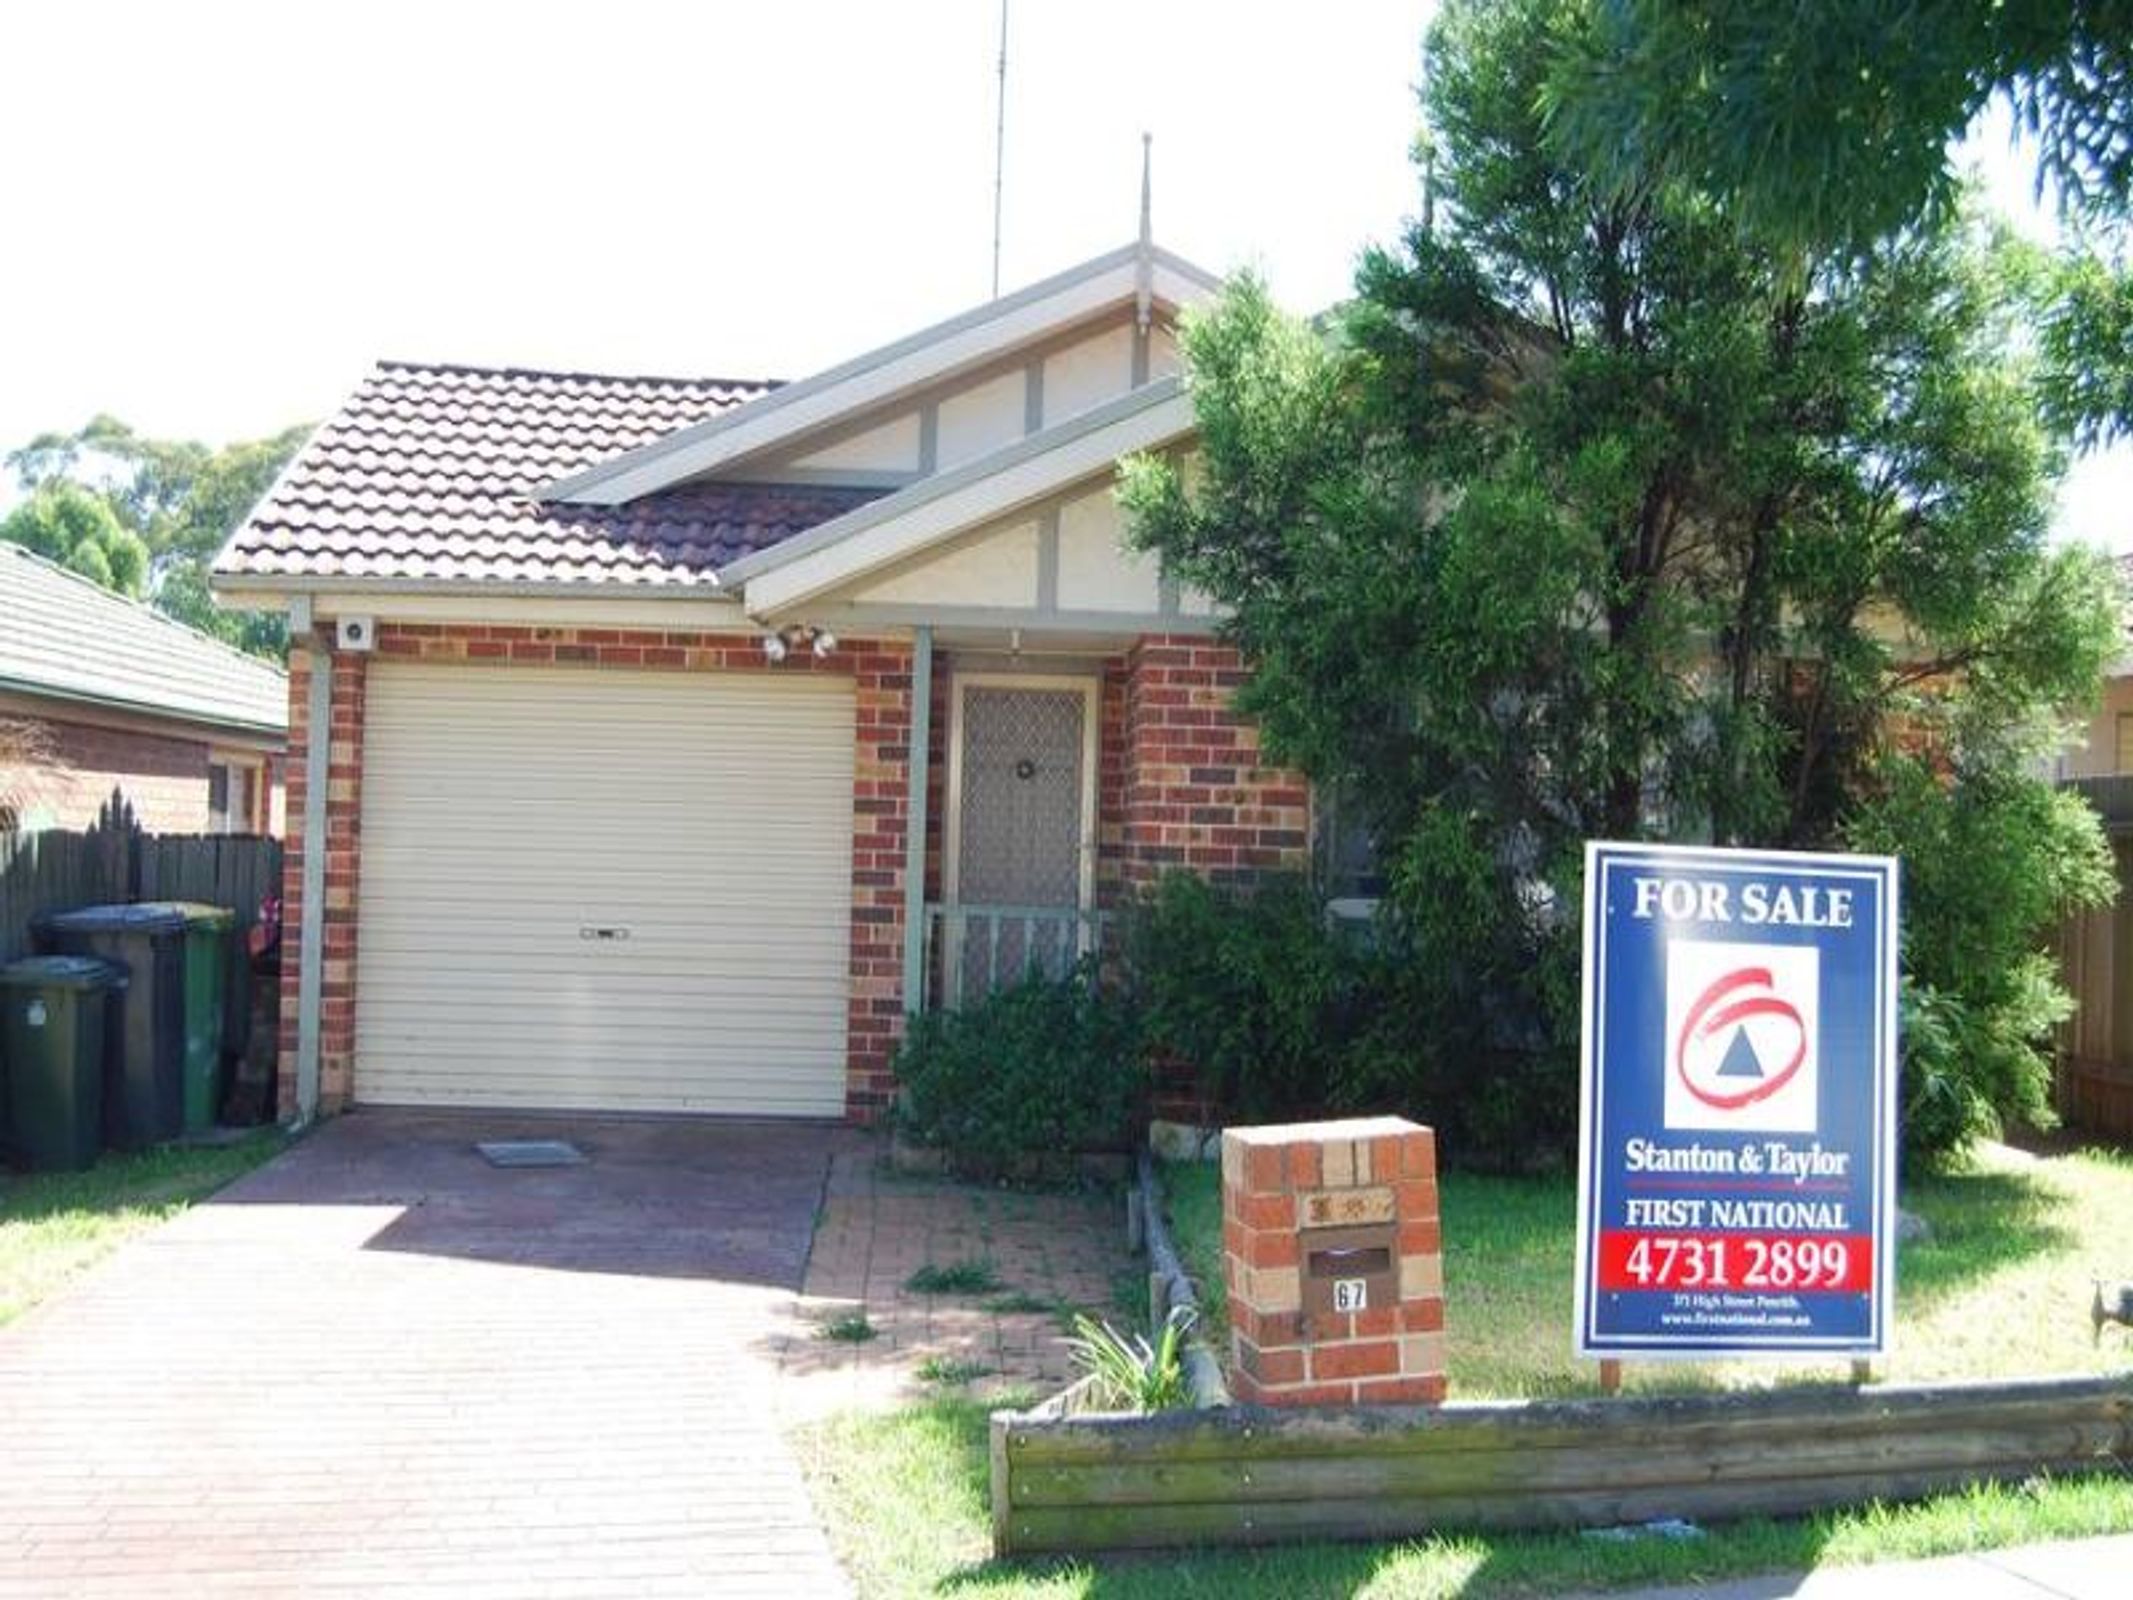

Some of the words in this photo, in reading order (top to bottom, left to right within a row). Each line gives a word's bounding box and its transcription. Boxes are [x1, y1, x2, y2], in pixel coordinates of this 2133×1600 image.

[1633, 878, 1730, 922] FOR
[1741, 885, 1853, 927] SALE
[1625, 1138, 1733, 1172] Stanton
[1738, 1147, 1763, 1173] &
[1764, 1143, 1849, 1184] Taylor
[1625, 1199, 1704, 1226] FIRST
[1711, 1202, 1849, 1229] NATIONAL
[1625, 1238, 1729, 1284] 4731
[1742, 1241, 1848, 1286] 2899
[1338, 1282, 1364, 1308] 67
